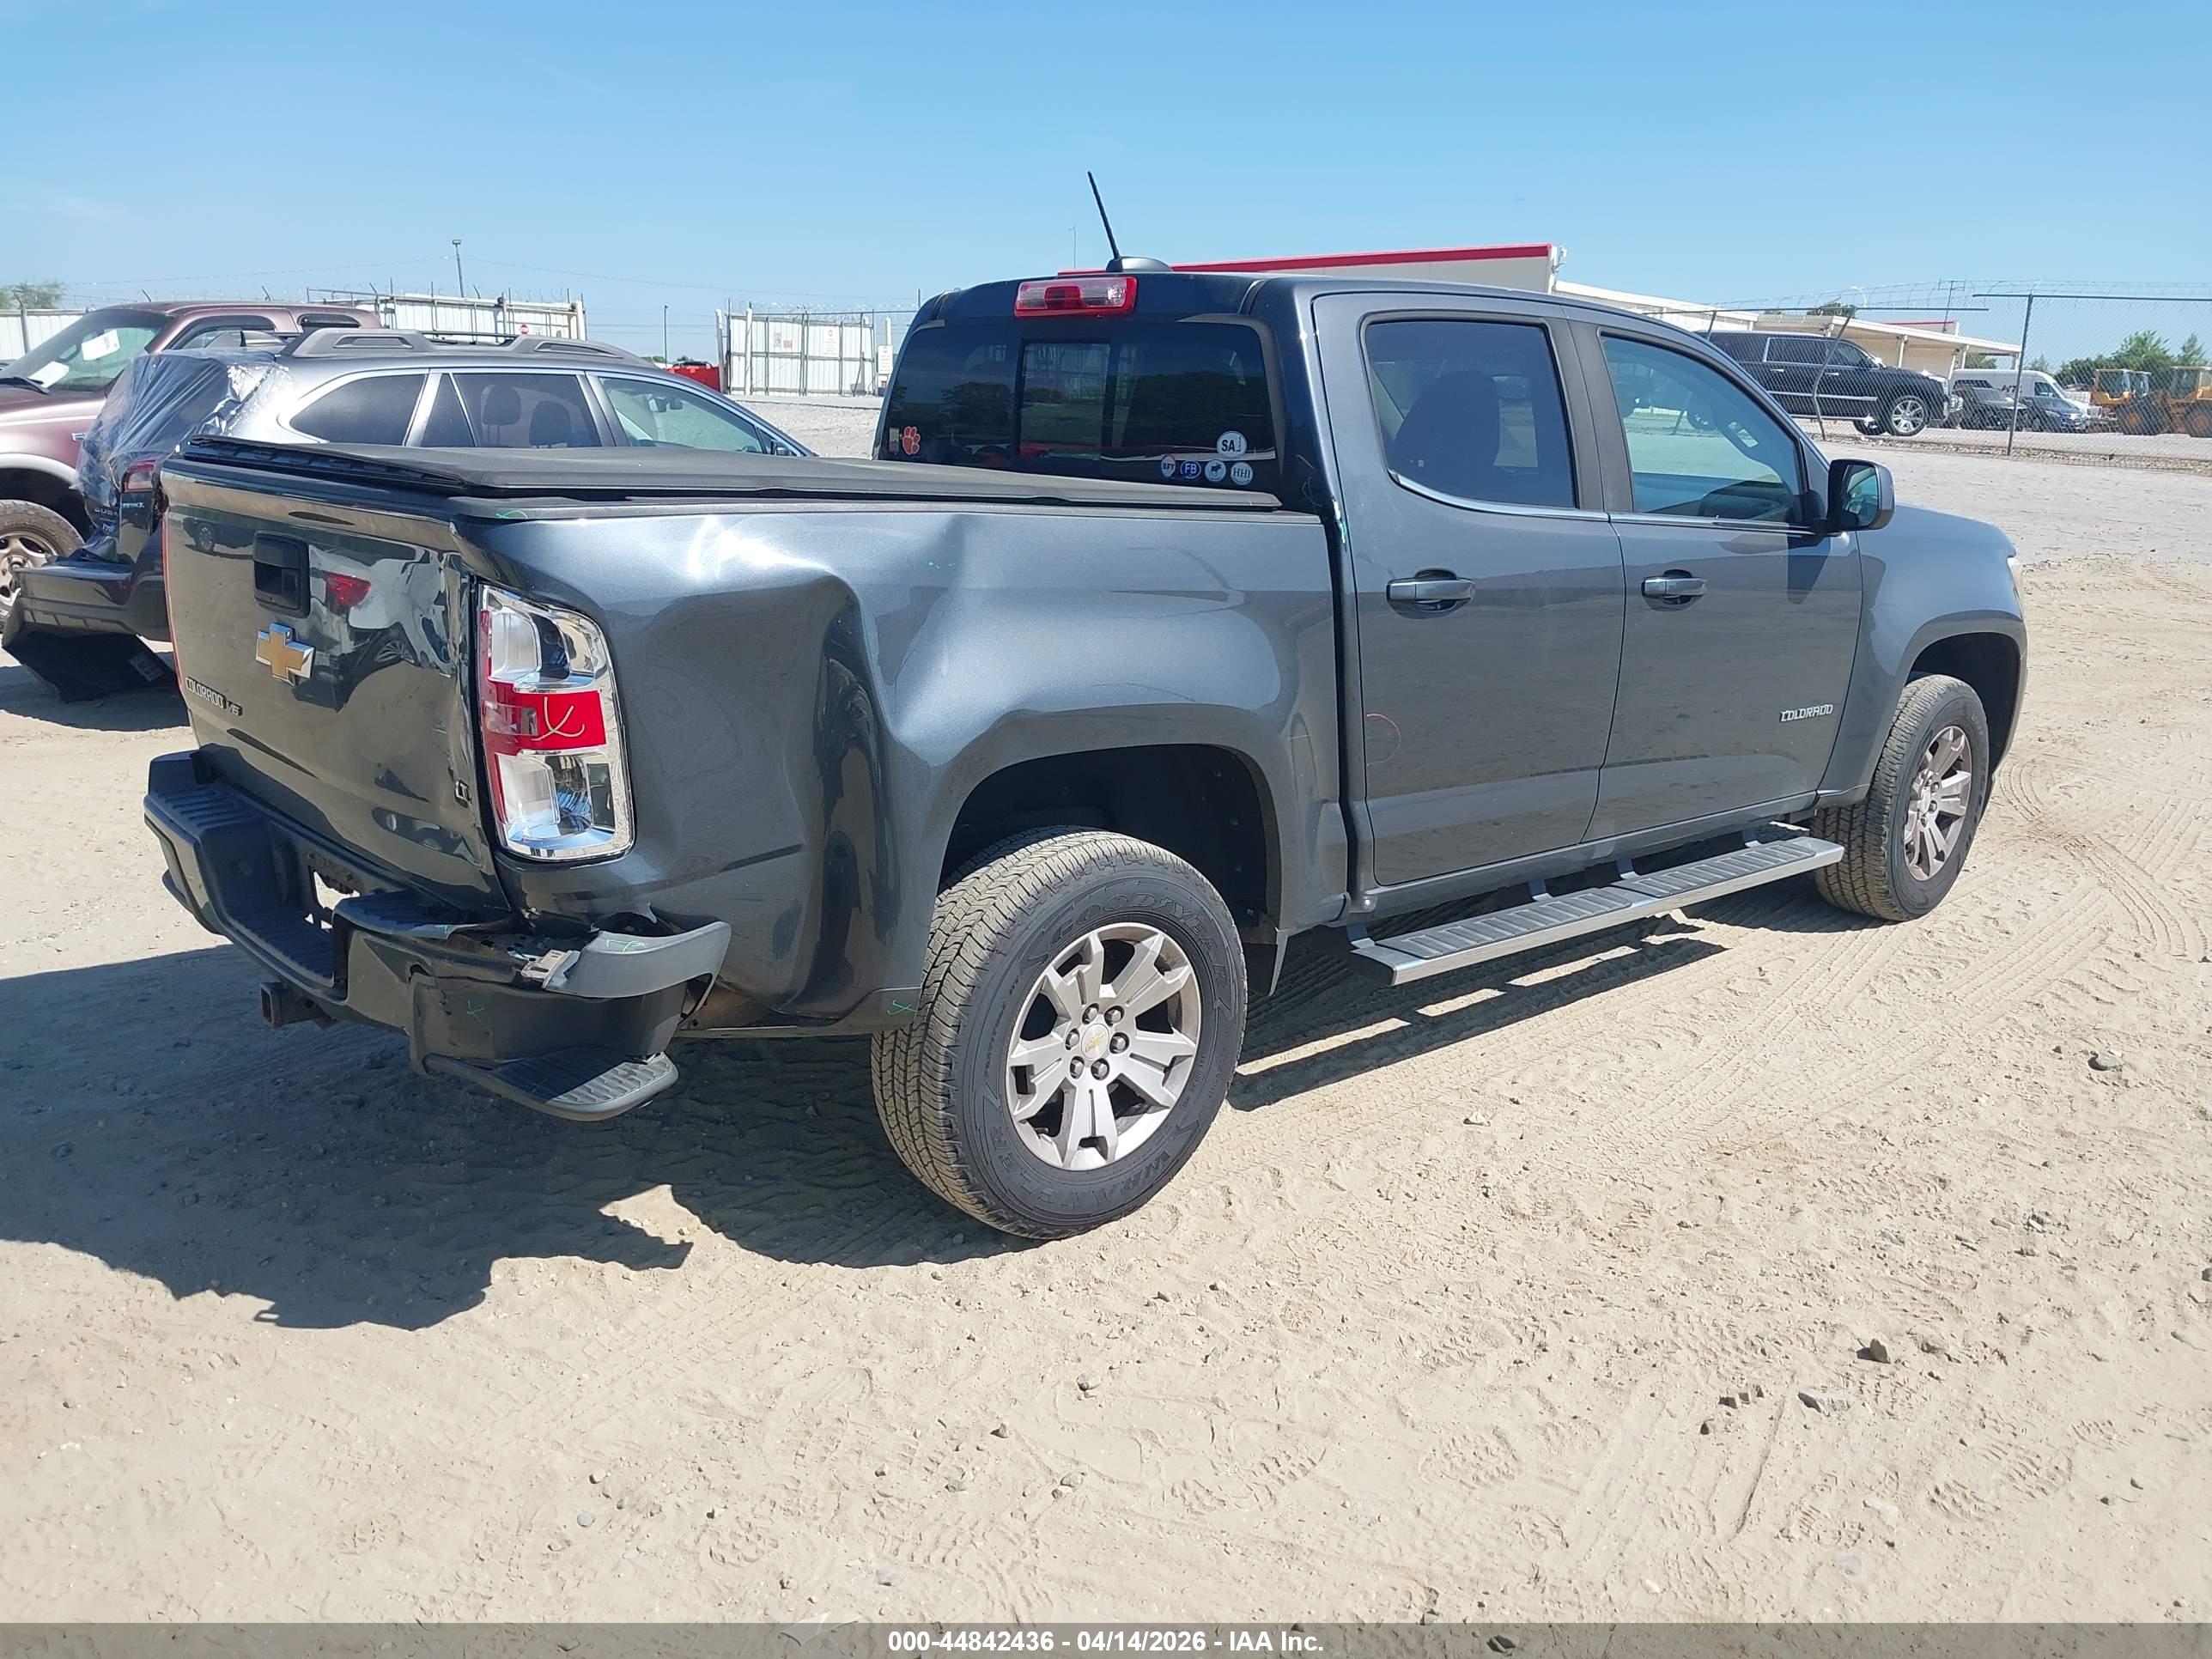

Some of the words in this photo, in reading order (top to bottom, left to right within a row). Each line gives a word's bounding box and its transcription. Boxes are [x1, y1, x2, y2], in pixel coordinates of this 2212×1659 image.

[1184, 463, 1197, 474] FB
[1233, 467, 1250, 478] HHI
[185, 677, 226, 709] COLORADO
[226, 700, 242, 716] V6
[1779, 703, 1833, 722] COLORADO
[1051, 892, 1228, 988] GOODYEAR
